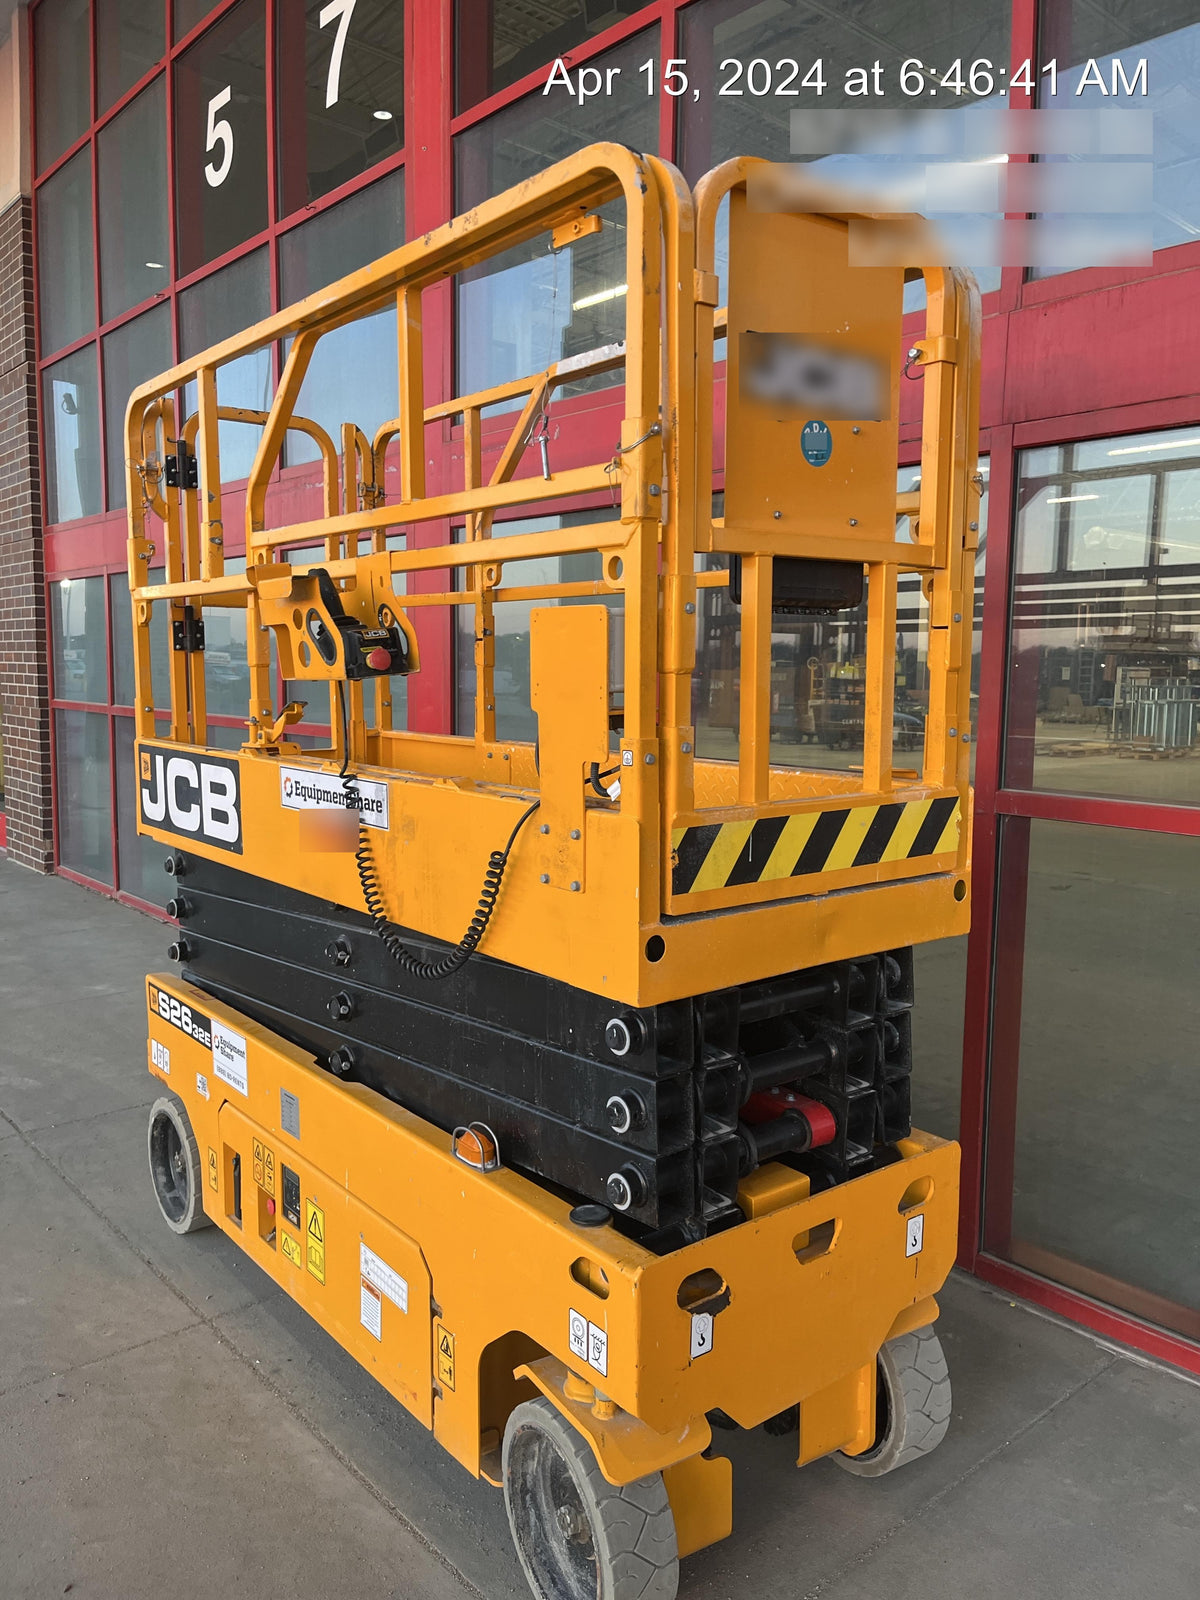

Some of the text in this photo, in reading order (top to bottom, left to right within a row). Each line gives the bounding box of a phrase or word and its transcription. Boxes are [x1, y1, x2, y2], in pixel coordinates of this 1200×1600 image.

[319, 0, 357, 109] 7
[204, 85, 234, 188] 5
[365, 630, 387, 638] JCB
[142, 754, 239, 843] JCB
[294, 780, 383, 814] Equipmenhare
[220, 1035, 246, 1060] Equipment
[220, 1046, 235, 1062] Share
